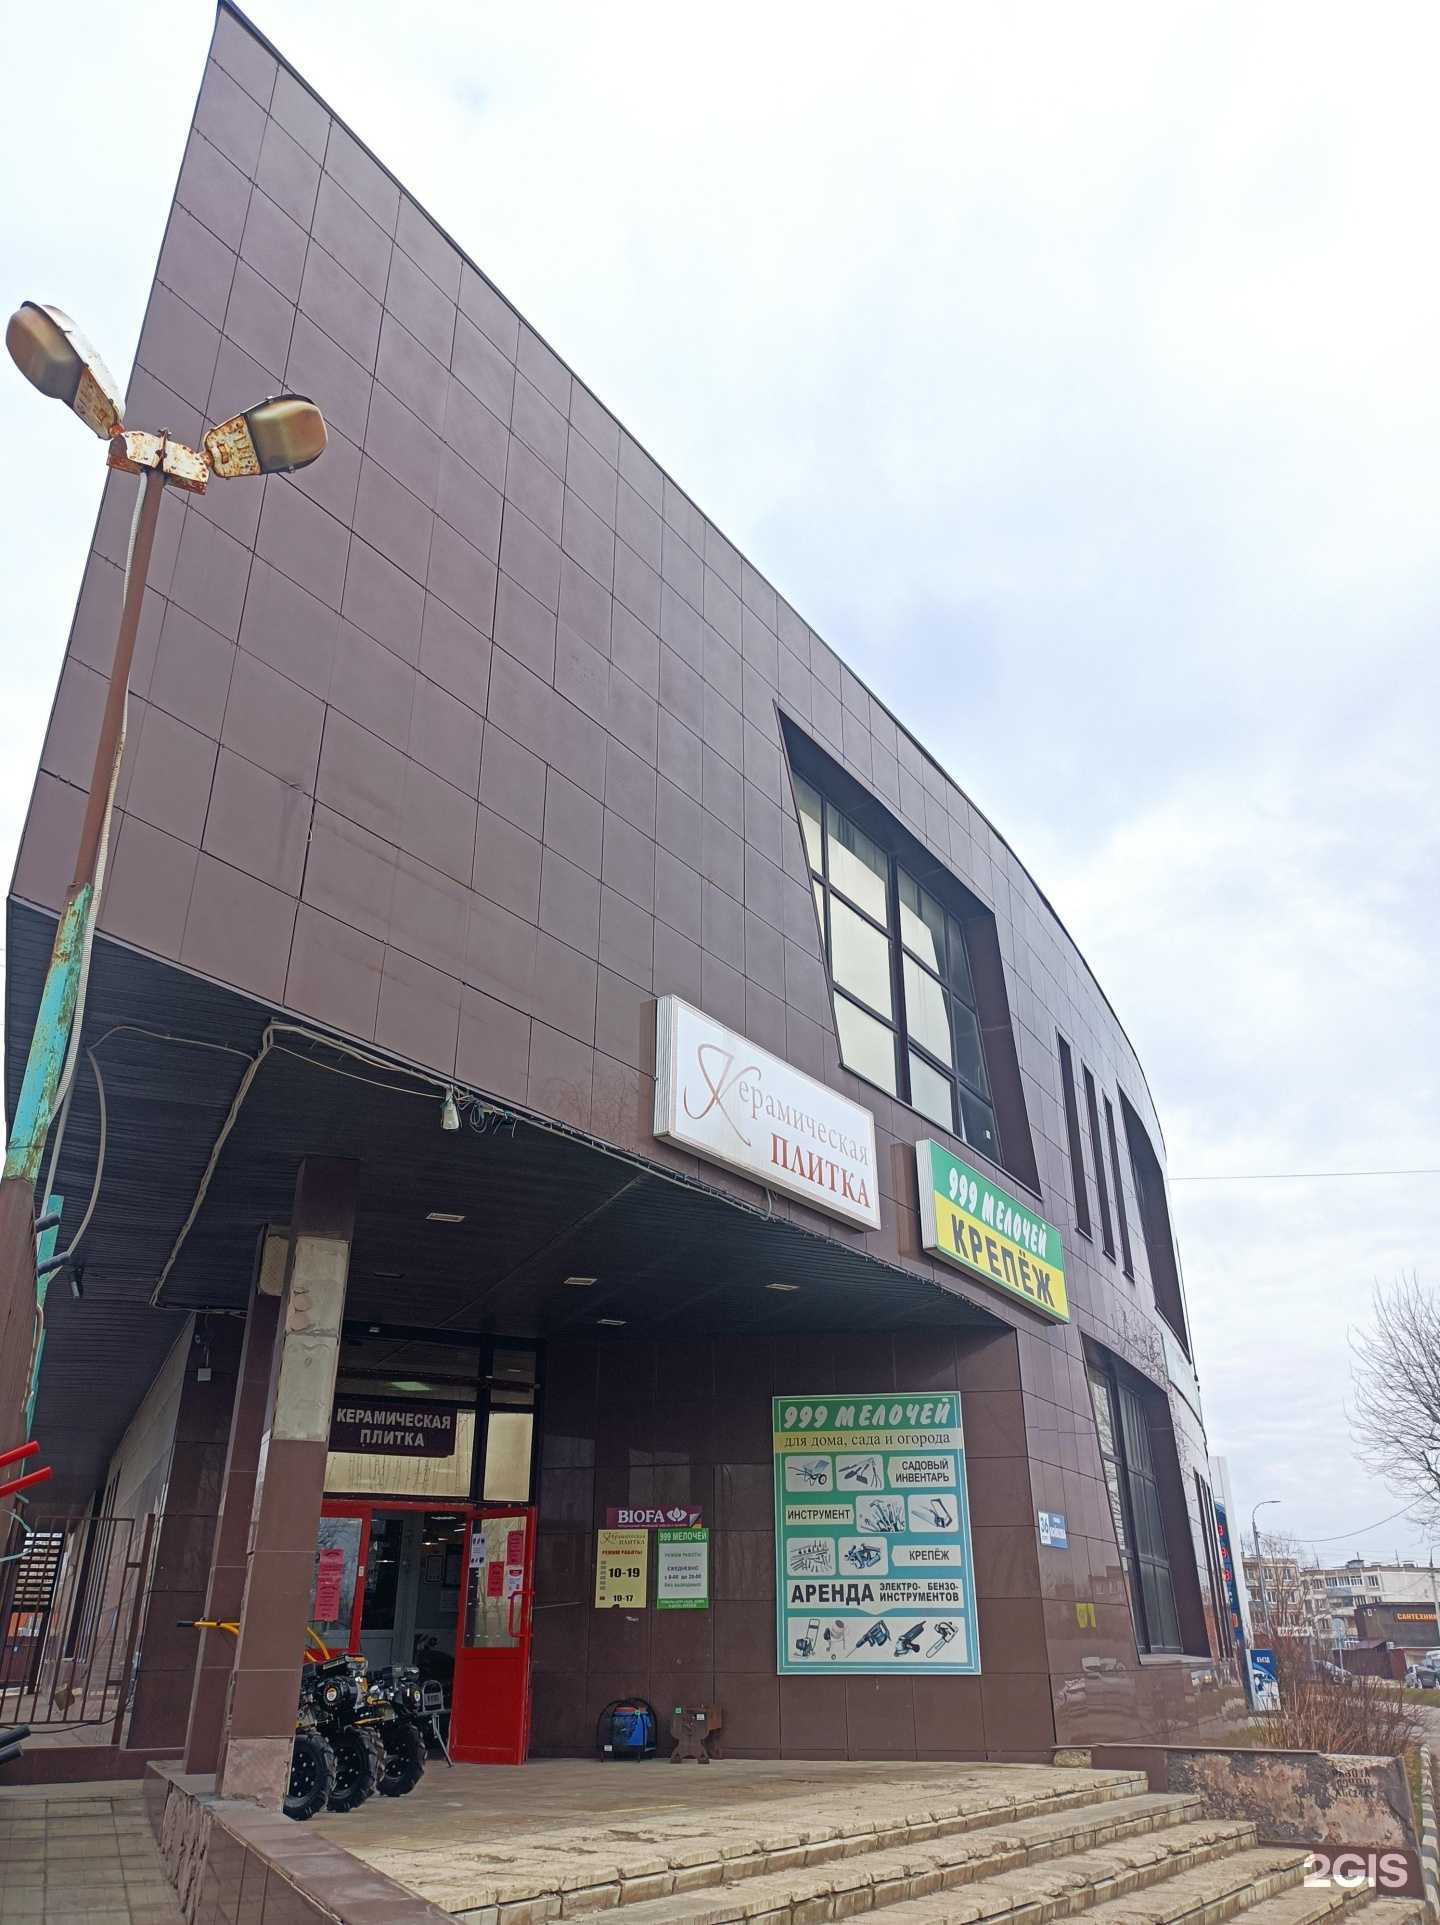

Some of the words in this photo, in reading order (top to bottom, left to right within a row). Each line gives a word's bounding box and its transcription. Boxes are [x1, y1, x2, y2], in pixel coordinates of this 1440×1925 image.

[770, 1132, 871, 1208] ПЛИТКА
[949, 1167, 978, 1214] 999
[982, 1191, 1047, 1258] МЕЛОЧЕЙ
[951, 1214, 1055, 1307] КРЕПЁЖ
[337, 1408, 451, 1429] КЕРАМИЧЕСКАЯ
[784, 1405, 828, 1429] 999
[834, 1398, 950, 1428] МЕЛОЧЕЙ
[360, 1429, 424, 1447] ПЛИТКА
[784, 1436, 807, 1447] для
[811, 1436, 848, 1447] дома,
[851, 1435, 881, 1446] сада
[885, 1436, 893, 1445] и
[897, 1433, 950, 1447] огорода
[902, 1458, 949, 1471] САДОВЫЙ
[895, 1472, 950, 1483] ИНВЕНТАРЬ
[618, 1510, 665, 1523] BIOFA
[787, 1509, 850, 1520] ИНСТРУМЕНТ
[909, 1548, 950, 1561] КРЕПЁЖ
[608, 1567, 640, 1578] 10-19
[791, 1583, 875, 1606] АРЕНДА
[879, 1582, 921, 1591] ЭЛЕКТРО-
[927, 1582, 960, 1591] БЕНЗО-
[879, 1591, 960, 1602] ИНСТРУМЕНТОВ
